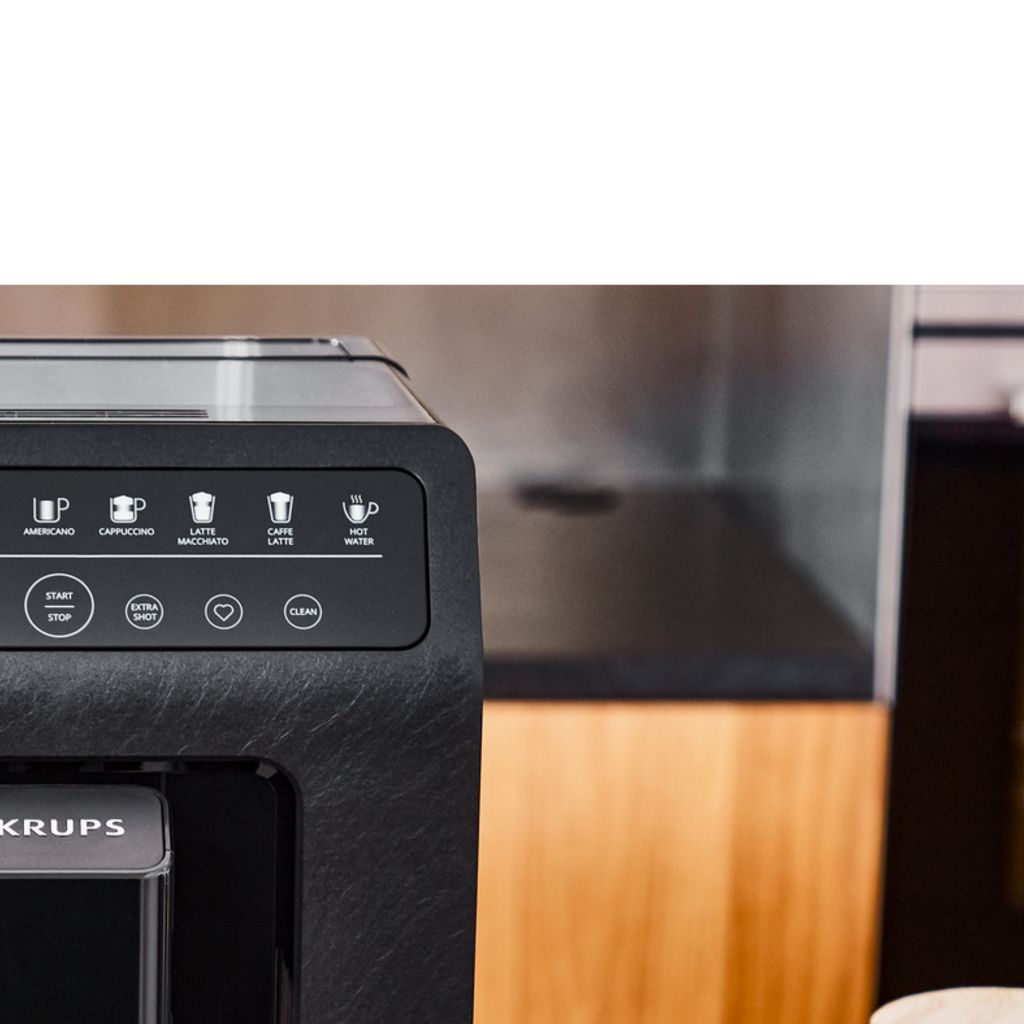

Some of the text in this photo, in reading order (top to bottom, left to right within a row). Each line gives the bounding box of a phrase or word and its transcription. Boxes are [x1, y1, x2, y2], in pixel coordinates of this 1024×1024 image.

[23, 527, 76, 536] AMERICANO
[98, 527, 155, 536] CAPPUCCINO
[189, 527, 216, 536] LATTE
[266, 527, 294, 536] CAFFE
[349, 527, 369, 536] HOT
[177, 537, 229, 546] MACCHIATO
[267, 537, 294, 546] LATTE
[343, 537, 375, 546] WATER
[45, 591, 74, 600] START
[130, 602, 159, 611] EXTRA
[289, 607, 318, 616] CLEAN
[47, 612, 72, 622] STOP
[132, 612, 158, 621] SHOT
